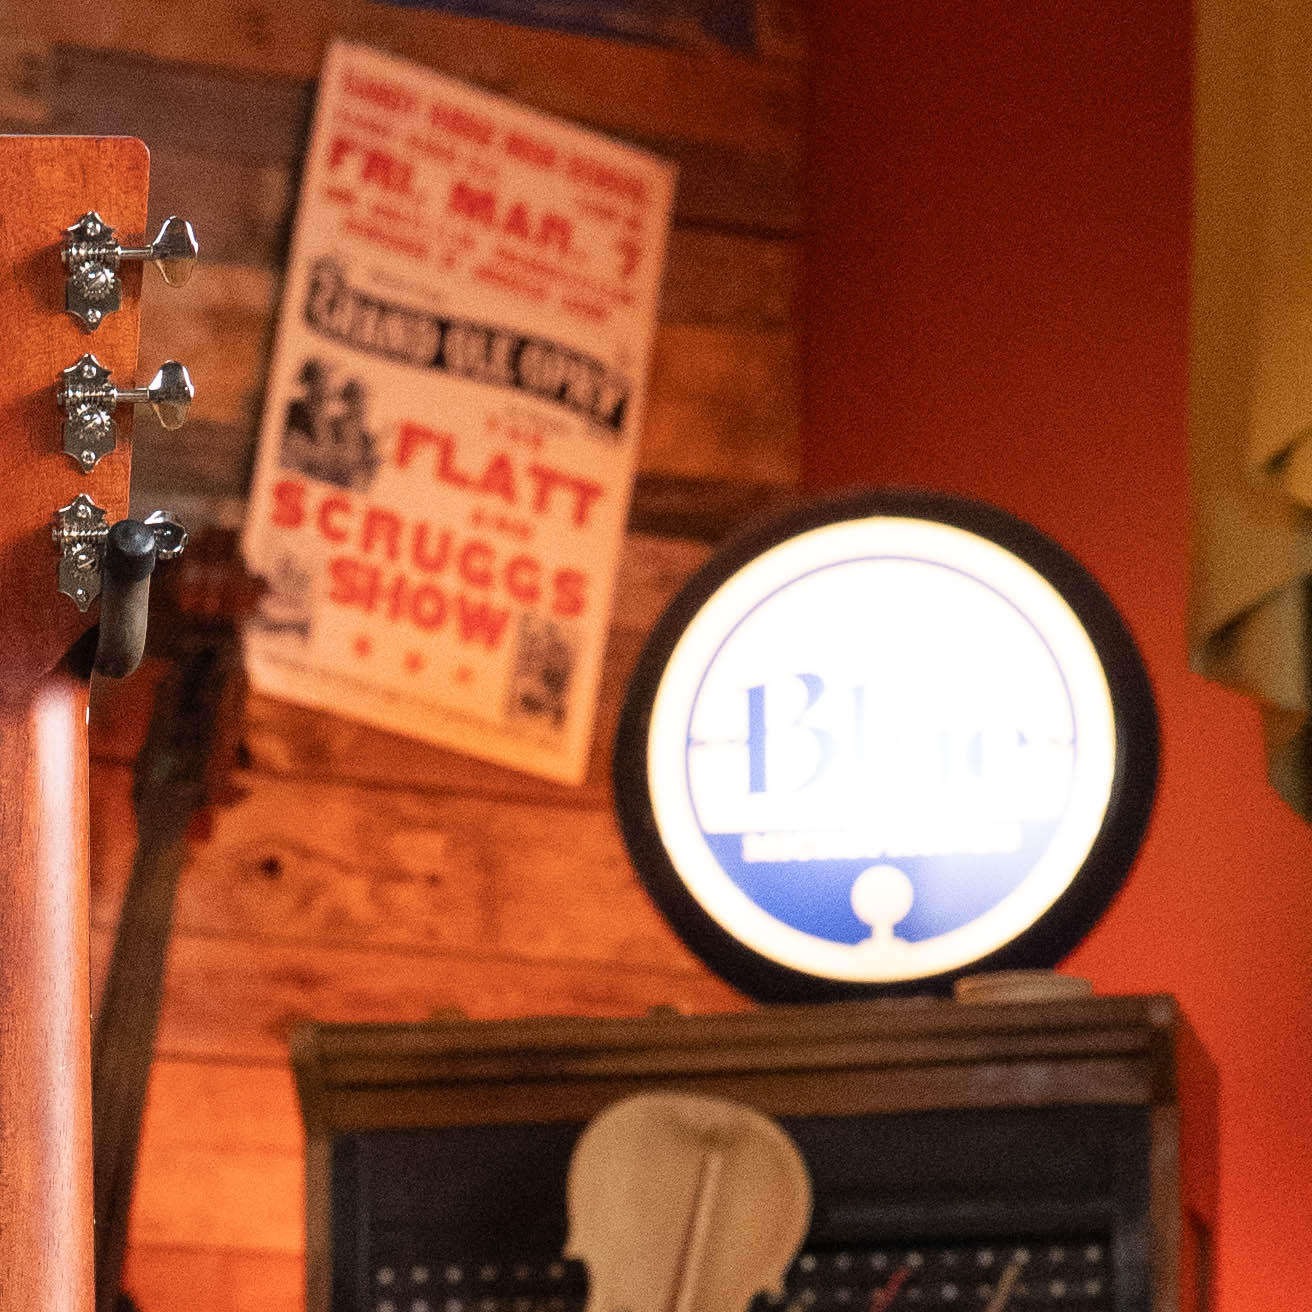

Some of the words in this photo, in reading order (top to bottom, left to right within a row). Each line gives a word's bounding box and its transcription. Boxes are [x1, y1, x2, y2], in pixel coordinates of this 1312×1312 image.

[395, 420, 606, 528] FLATT
[271, 479, 587, 619] SCRUGGS
[328, 556, 511, 654] SHOW
